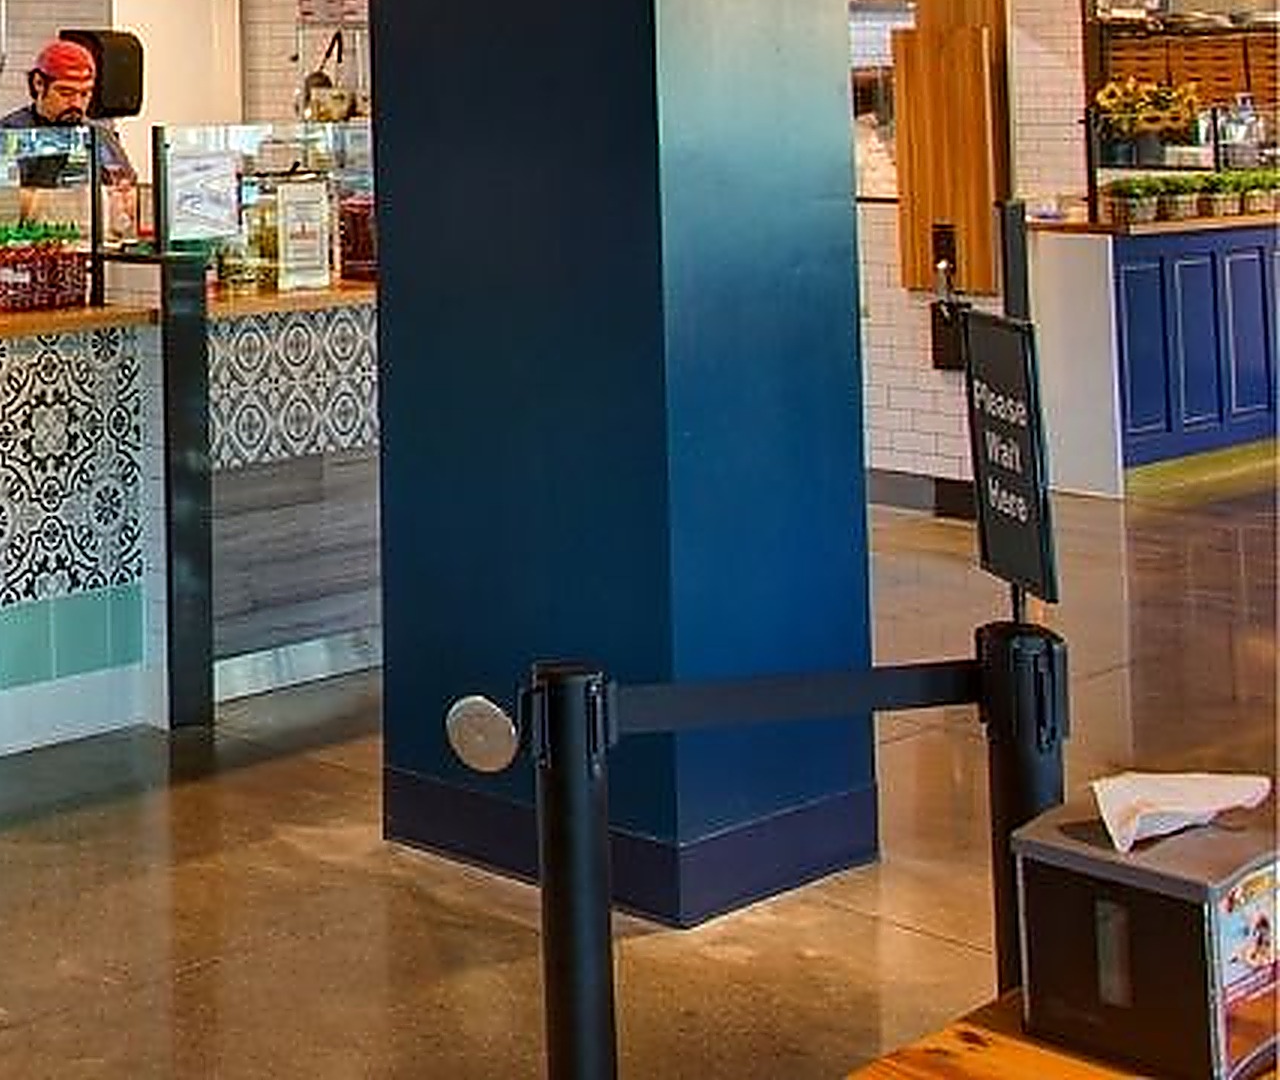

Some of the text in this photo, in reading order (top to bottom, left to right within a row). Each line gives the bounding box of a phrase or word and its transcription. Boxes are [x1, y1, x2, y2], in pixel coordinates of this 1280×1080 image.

[973, 379, 1028, 427] Please
[986, 431, 1023, 474] Wait
[989, 476, 1028, 523] Here
